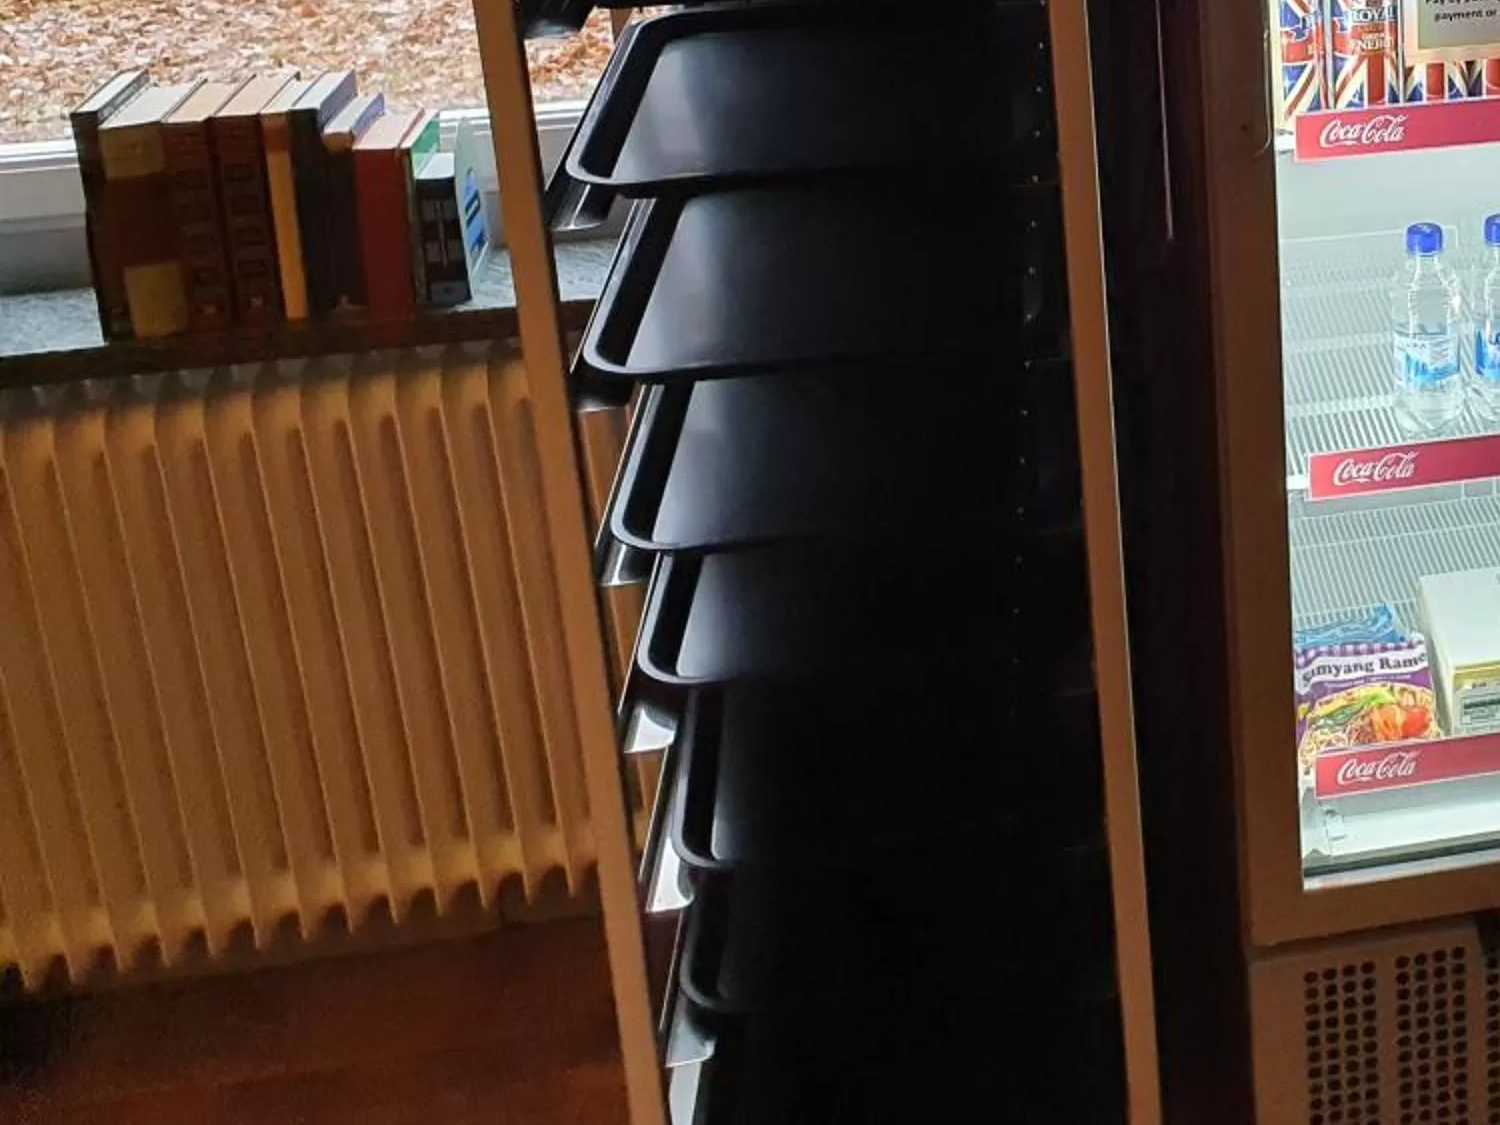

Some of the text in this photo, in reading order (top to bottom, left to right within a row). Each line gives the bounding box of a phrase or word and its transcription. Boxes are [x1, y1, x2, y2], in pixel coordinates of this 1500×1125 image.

[1318, 113, 1408, 150] Coca-Cola
[1332, 451, 1421, 486] Coca-Cola
[1378, 652, 1426, 671] Rame
[1337, 751, 1422, 785] Coca-Cola
